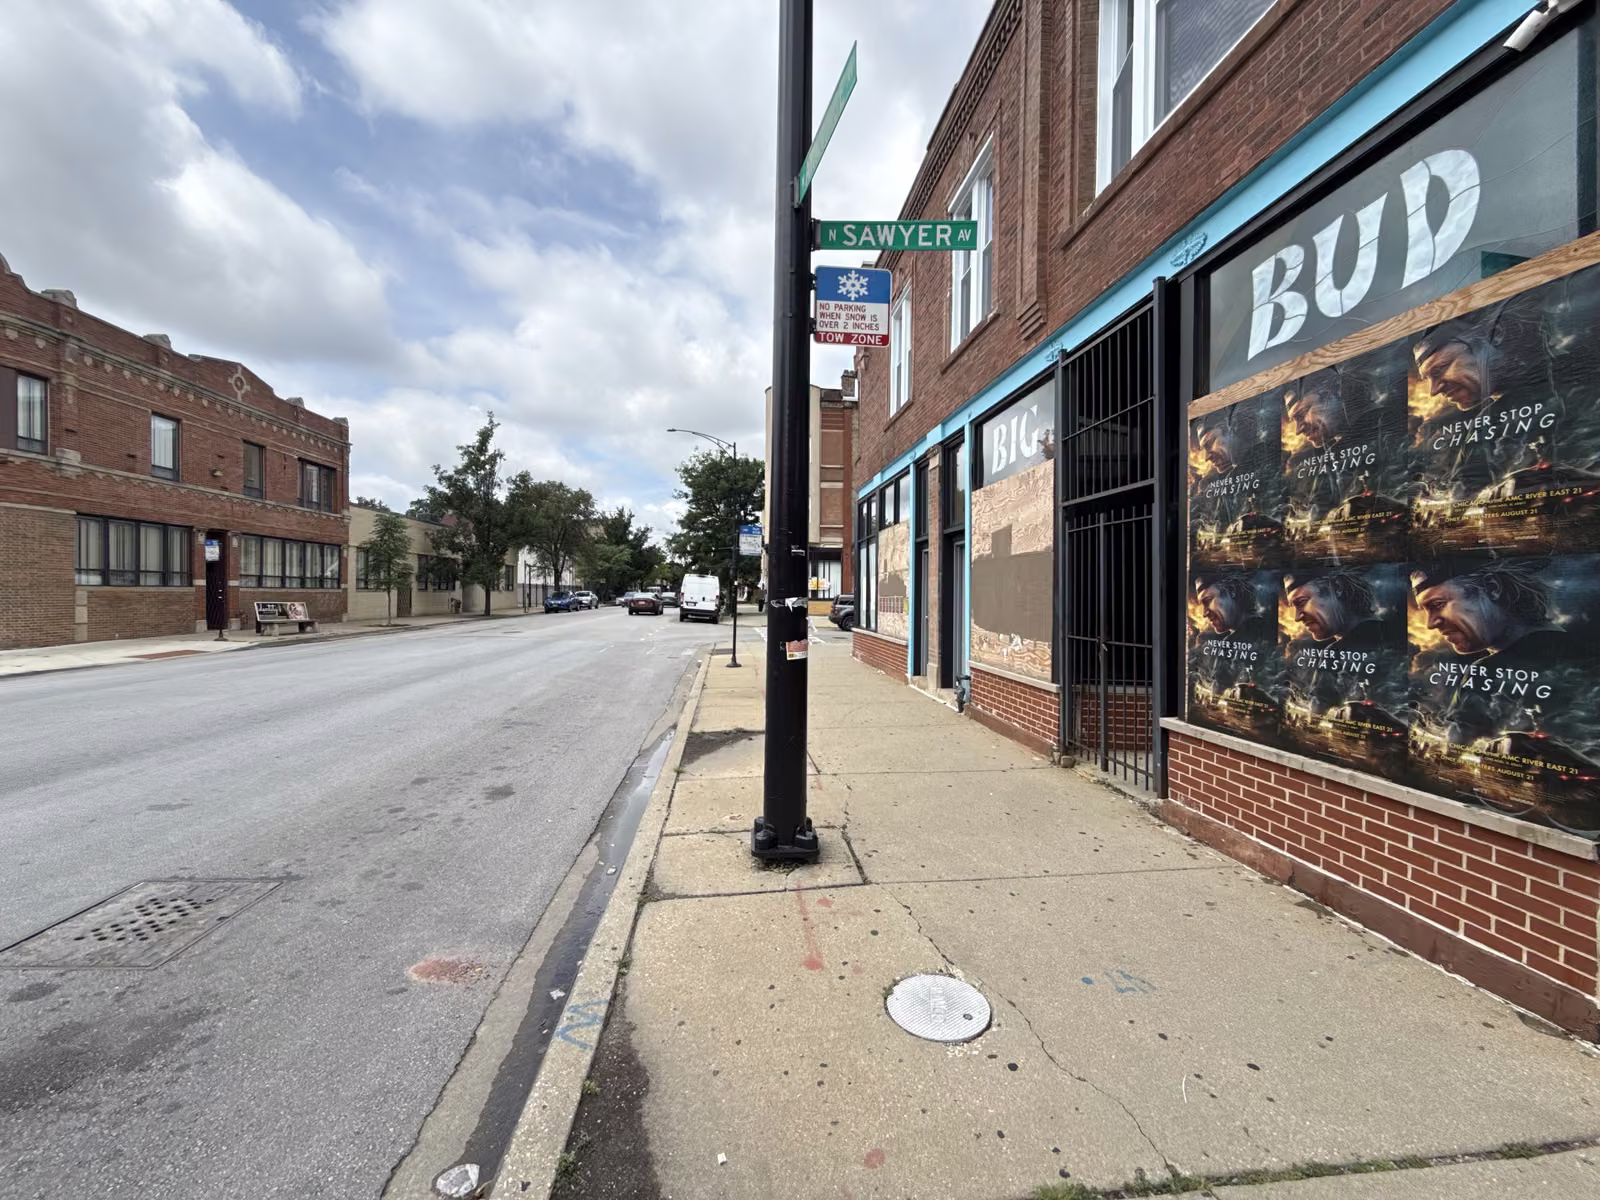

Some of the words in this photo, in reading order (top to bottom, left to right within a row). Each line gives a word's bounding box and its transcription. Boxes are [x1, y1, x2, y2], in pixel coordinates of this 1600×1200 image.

[828, 228, 836, 242] N
[843, 224, 952, 247] SAWYER
[957, 228, 972, 242] AV
[1247, 149, 1481, 361] BUD
[819, 303, 830, 311] NO
[834, 304, 866, 313] PARKING
[819, 311, 841, 320] WHEN
[845, 313, 866, 322] SNOW
[871, 314, 878, 323] IS
[819, 320, 839, 329] OVER
[843, 322, 849, 330] 2
[852, 322, 880, 331] INCHES
[819, 332, 844, 343] TOW
[850, 334, 883, 345] ZONE
[1443, 415, 1490, 435] NEVER
[1500, 403, 1543, 423] STOP
[992, 404, 1039, 475] BIG
[1433, 413, 1555, 451] CHASING
[1304, 452, 1335, 467] NEVER
[1340, 444, 1368, 459] STOP
[1298, 453, 1376, 479] CHASING
[1206, 479, 1260, 498] CHASING
[1210, 477, 1233, 489] NEVER
[1235, 472, 1255, 483] STOP
[1525, 491, 1547, 499] RIVER
[1549, 489, 1570, 497] EAST
[1501, 509, 1528, 517] AUGUST
[1203, 646, 1257, 661] CHASING
[1207, 639, 1231, 650] NEVER
[1233, 641, 1252, 651] STOP
[1303, 648, 1335, 659] NEVER
[1340, 651, 1368, 662] STOP
[1297, 657, 1376, 674] CHASING
[1439, 662, 1487, 677] NEVER
[1496, 668, 1539, 682] STOP
[1429, 672, 1552, 699] CHASING
[1496, 768, 1524, 778] AUGUST
[1501, 755, 1520, 763] AMC
[1522, 758, 1544, 768] RIVER
[1547, 763, 1567, 772] EAST
[1569, 767, 1579, 775] 21
